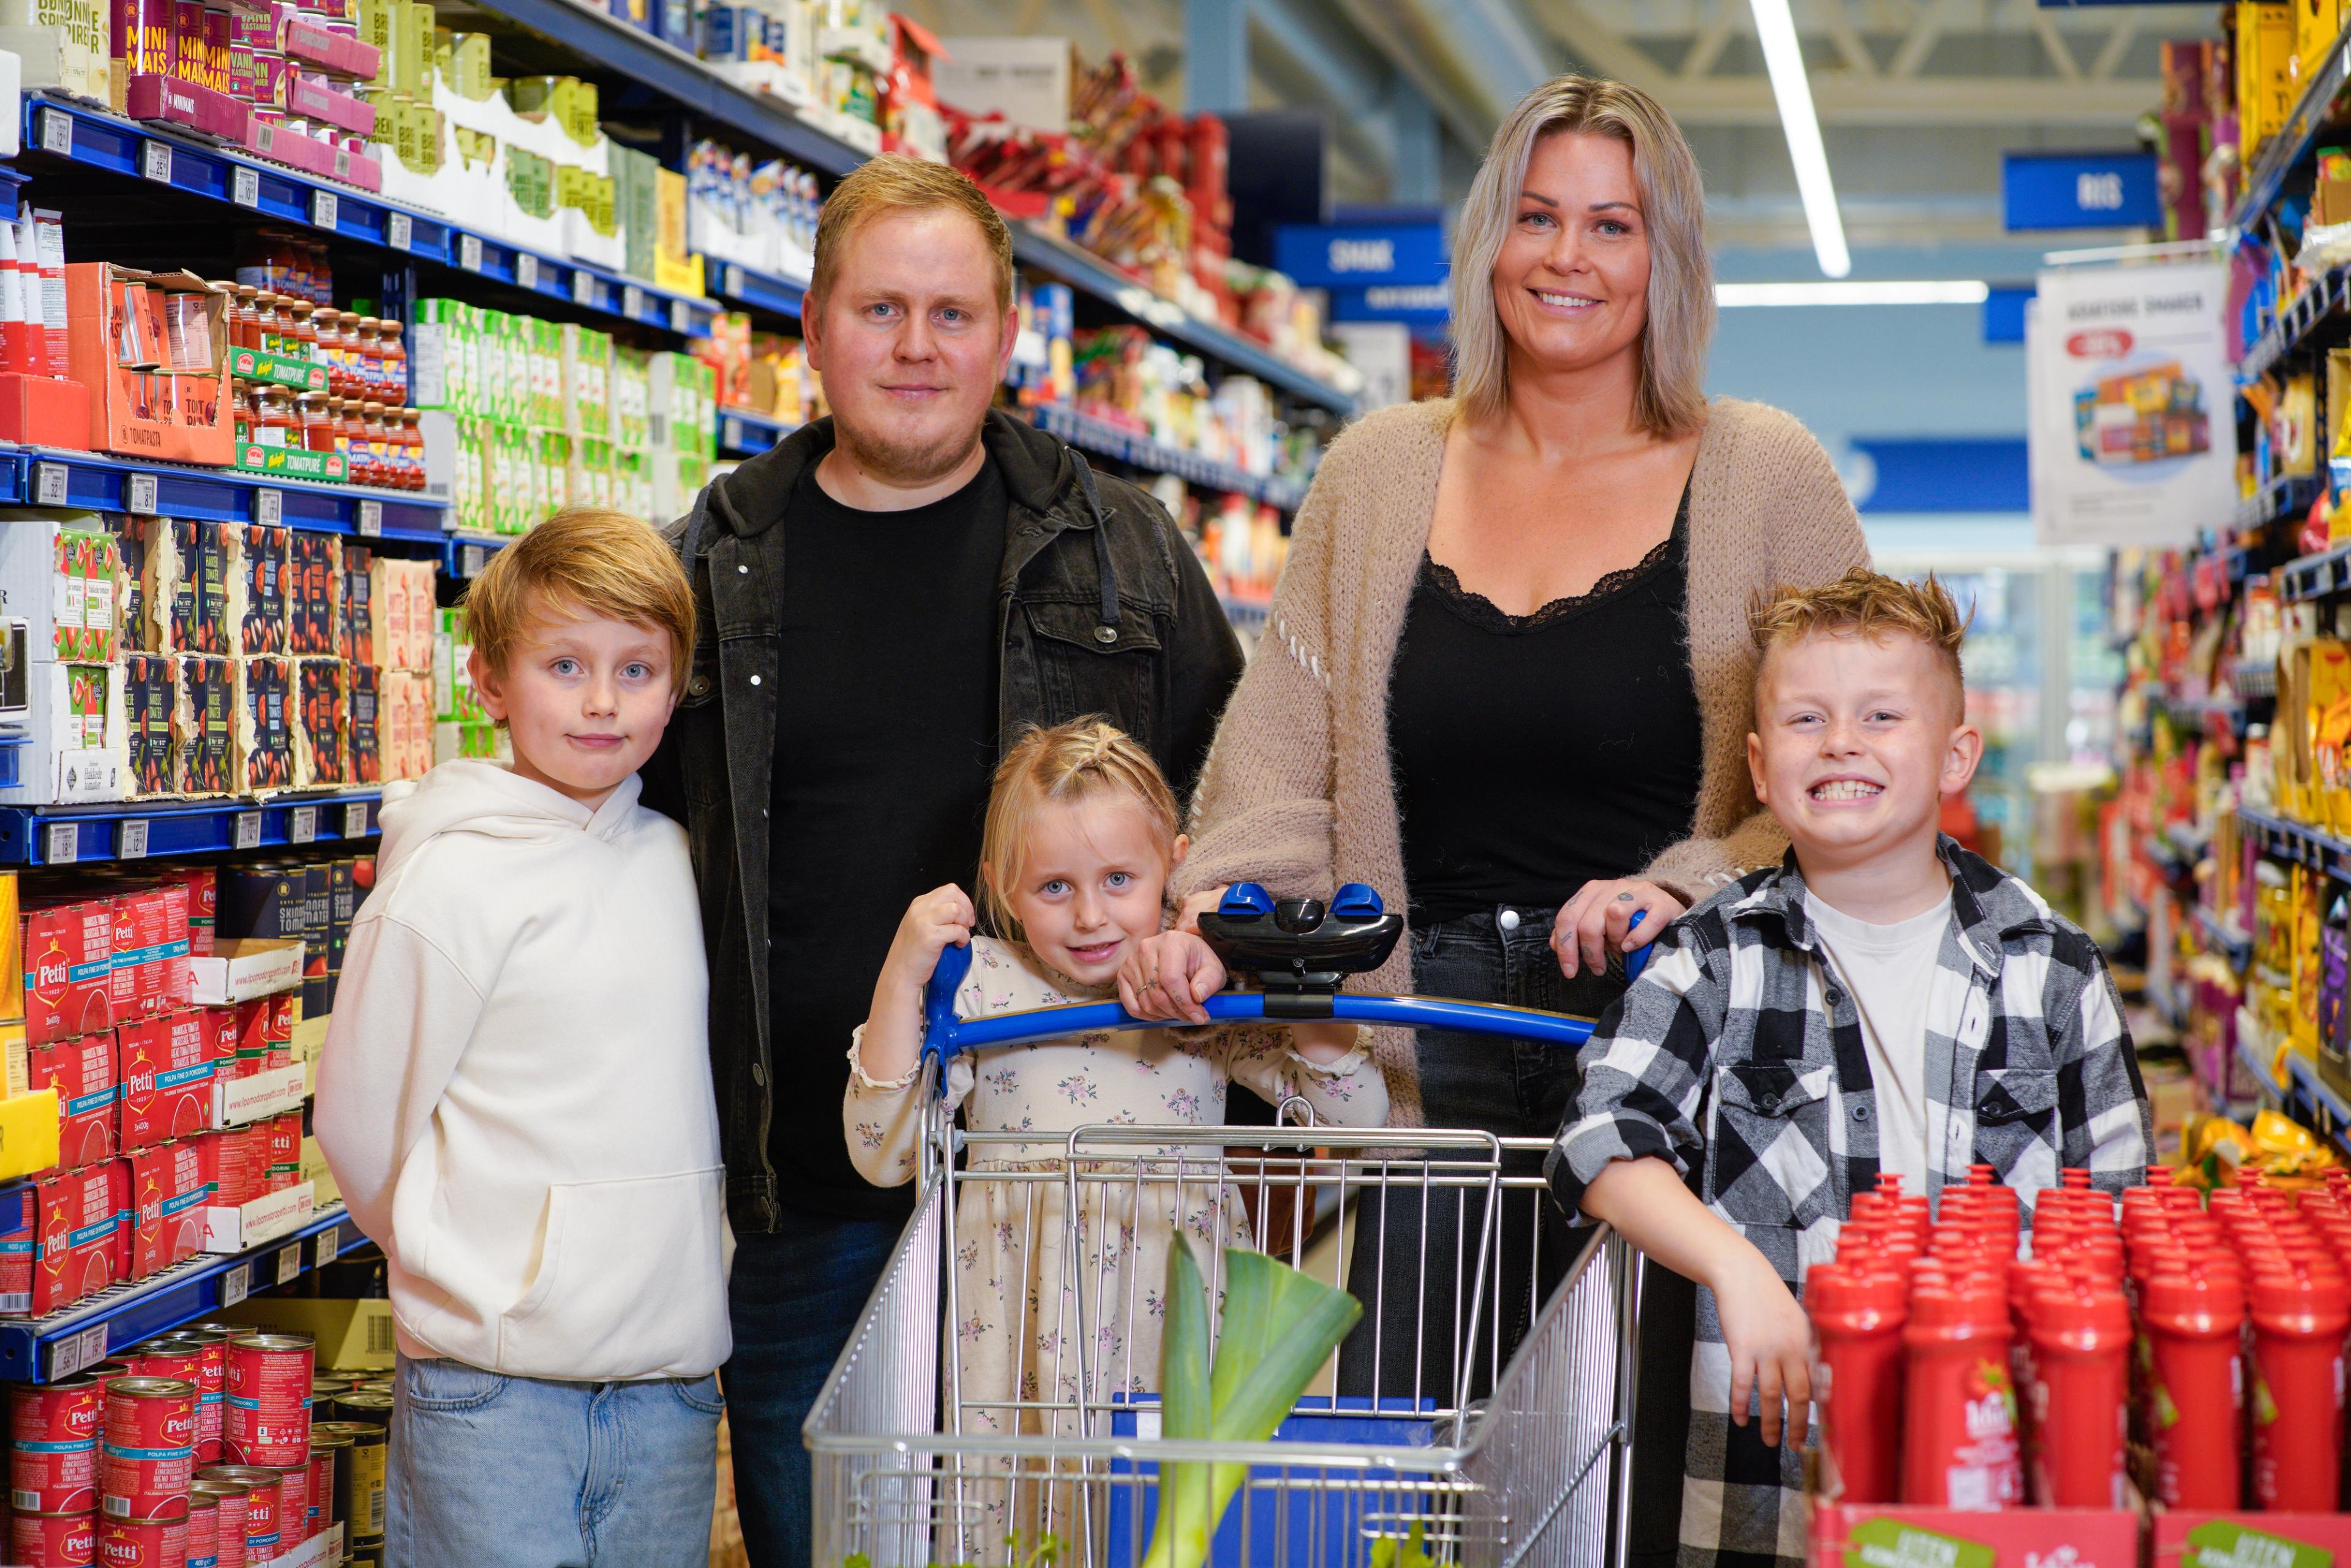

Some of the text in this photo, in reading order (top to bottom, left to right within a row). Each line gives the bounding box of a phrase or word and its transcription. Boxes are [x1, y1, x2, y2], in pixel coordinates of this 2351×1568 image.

[127, 25, 167, 51] MINI
[127, 51, 167, 75] MAIS
[173, 93, 195, 114] MINIMAIS
[57, 132, 62, 148] 12
[157, 160, 163, 177] 25
[246, 186, 250, 201] 10
[274, 365, 306, 384] TOMATPURÉ
[130, 426, 162, 448] TOMATPASTA
[287, 454, 321, 474] TOMATPURÉ
[84, 767, 102, 779] Hakkede
[84, 780, 101, 790] tomater
[133, 838, 139, 852] 12
[116, 925, 133, 942] Petti
[40, 961, 67, 988] Petti
[187, 970, 199, 986] A
[189, 1066, 208, 1078] POMODORO
[130, 1069, 153, 1096] Petti
[134, 1122, 149, 1132] 3x400g
[141, 1198, 160, 1225] Petti
[202, 1224, 214, 1239] A
[47, 1228, 67, 1257] Petti
[71, 1409, 97, 1427] Petti
[167, 1416, 192, 1433] Petti
[67, 1536, 96, 1552] Petti
[255, 1536, 279, 1545] POMODORO
[104, 1542, 137, 1561] Petti
